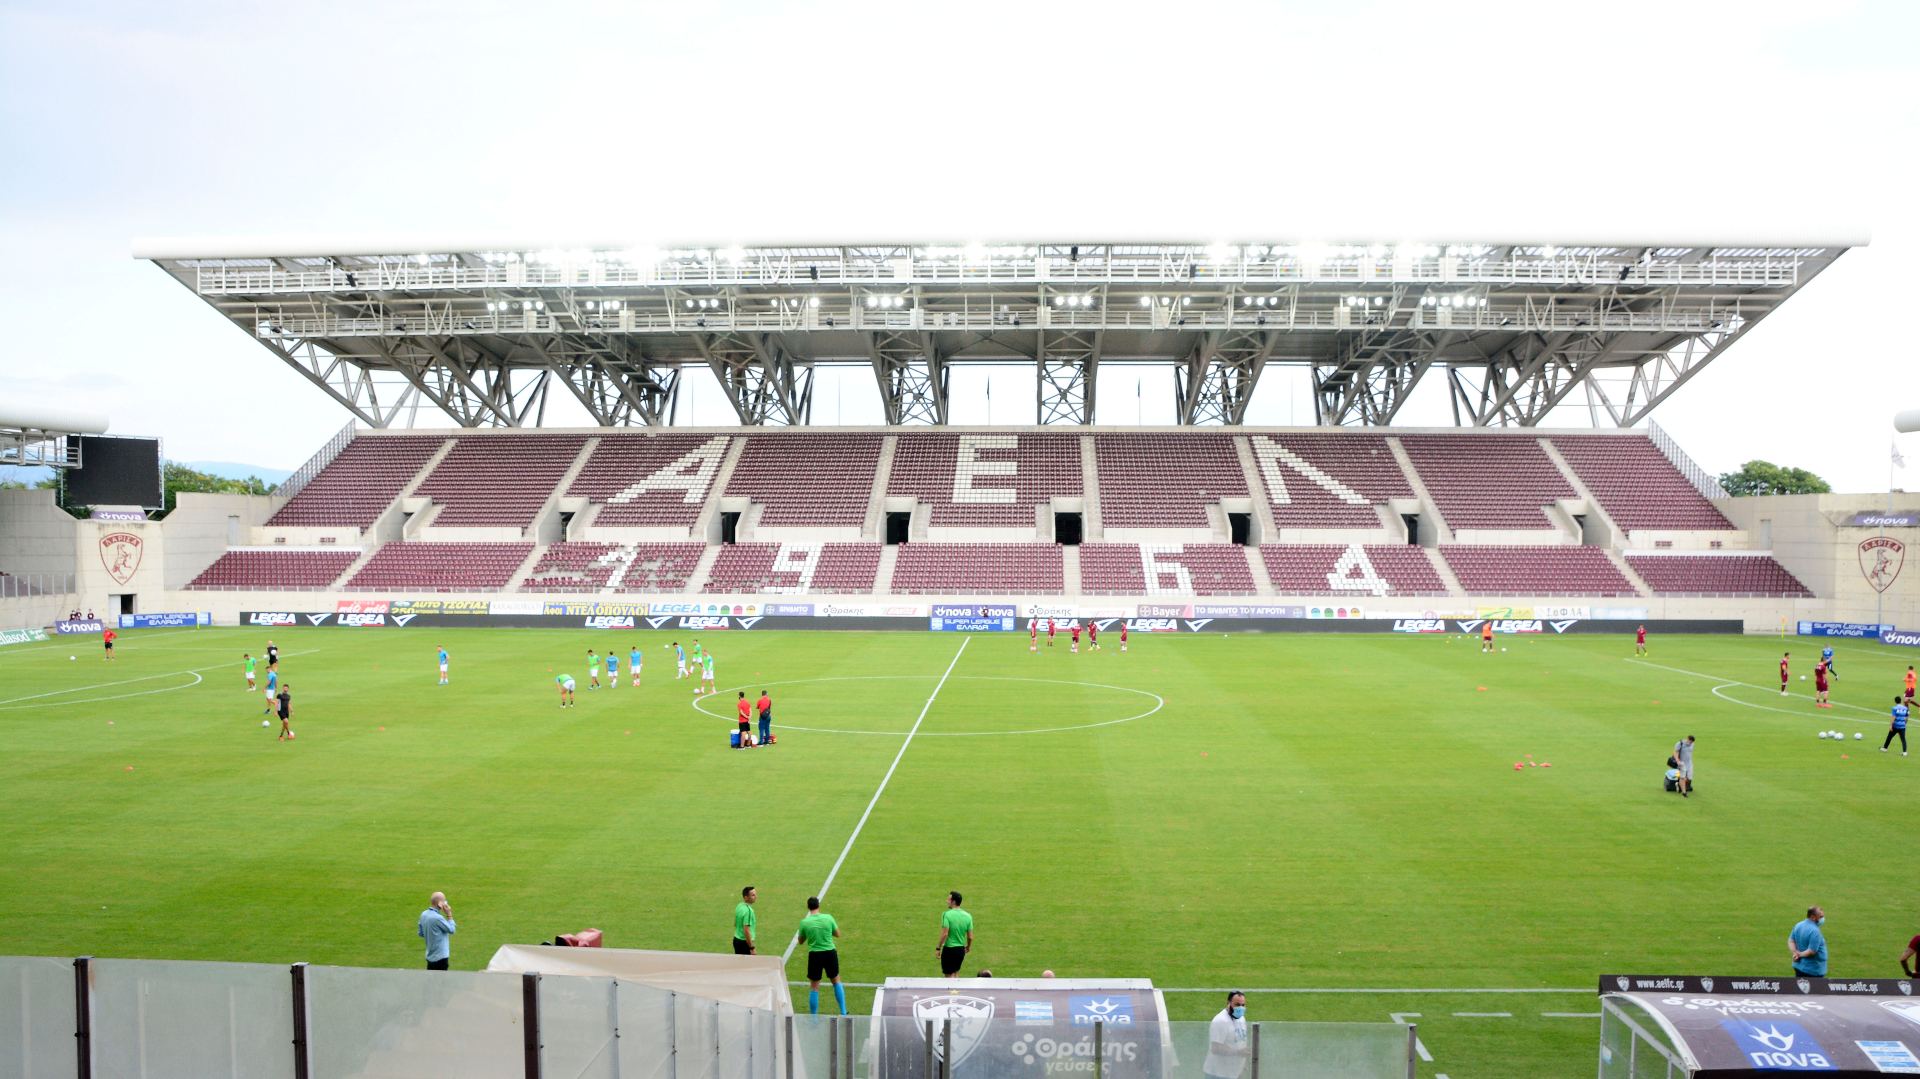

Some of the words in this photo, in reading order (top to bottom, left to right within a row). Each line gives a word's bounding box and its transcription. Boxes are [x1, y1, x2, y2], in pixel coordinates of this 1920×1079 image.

[111, 513, 142, 521] nova
[1875, 517, 1908, 525] nova
[651, 604, 702, 613] LEGEA
[945, 607, 972, 617] nova
[988, 607, 1014, 617] nova
[1152, 607, 1180, 617] Bayer
[250, 613, 297, 624] LEGEA
[337, 614, 385, 625] LEGEA
[584, 616, 635, 627] LEGEA
[678, 617, 730, 628] LEGEA
[72, 622, 102, 633] nova
[1127, 619, 1178, 630] LEGEA
[1393, 620, 1446, 631] LEGEA
[1491, 620, 1543, 631] LEGEA
[1896, 634, 1920, 645] nov
[1074, 1014, 1131, 1026] nova
[1750, 1051, 1831, 1069] nova
